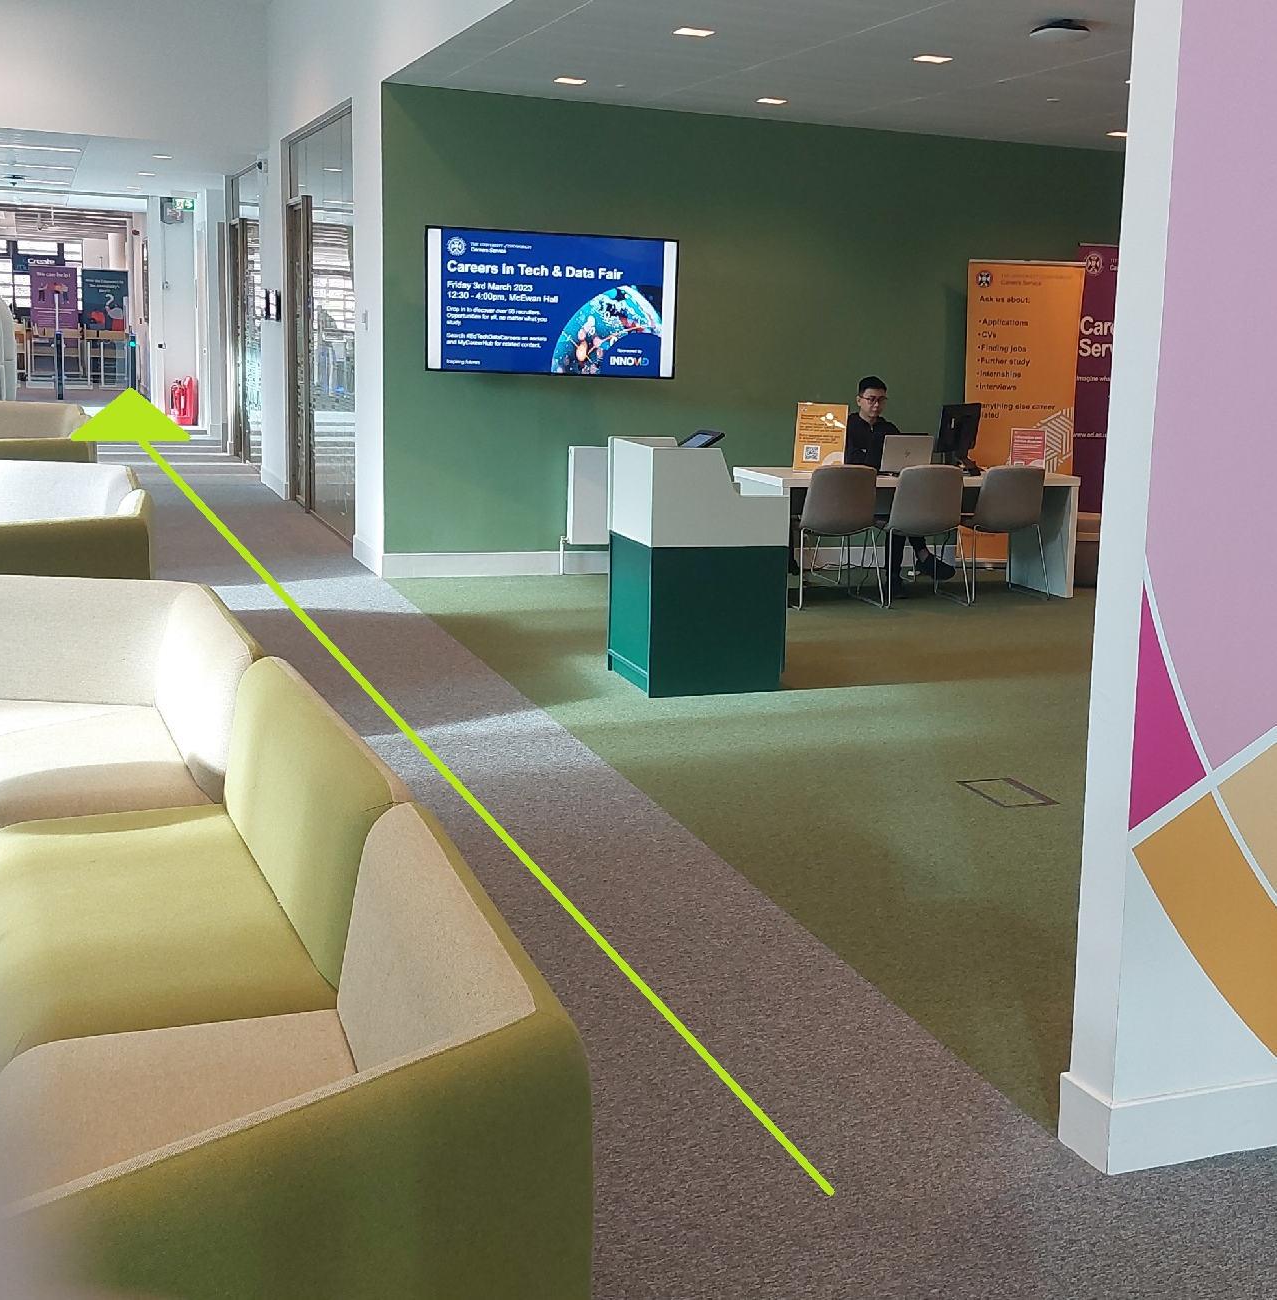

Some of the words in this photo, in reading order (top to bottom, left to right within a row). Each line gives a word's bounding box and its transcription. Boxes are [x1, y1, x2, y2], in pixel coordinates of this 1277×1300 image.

[447, 259, 499, 275] Careers
[517, 263, 549, 277] Tech
[551, 266, 563, 278] &
[565, 266, 595, 279] Data
[598, 267, 624, 281] Fair
[447, 280, 472, 291] Friday
[472, 281, 486, 290] 3rd
[487, 282, 512, 291] March
[513, 284, 533, 292] 2023
[447, 291, 469, 299] 12:30
[475, 292, 507, 301] 4:00pm,
[508, 293, 542, 302] McEwan
[543, 295, 559, 303] Hall
[979, 295, 994, 303] Ask
[1006, 295, 1031, 304] about:
[981, 318, 1029, 327] Applications
[981, 331, 997, 339] CVs
[981, 344, 1009, 354] Finding
[1009, 345, 1027, 354] jobs
[980, 357, 1007, 365] Further
[1009, 358, 1031, 367] study
[980, 370, 1022, 378] Internships
[979, 383, 1017, 391] Interviews
